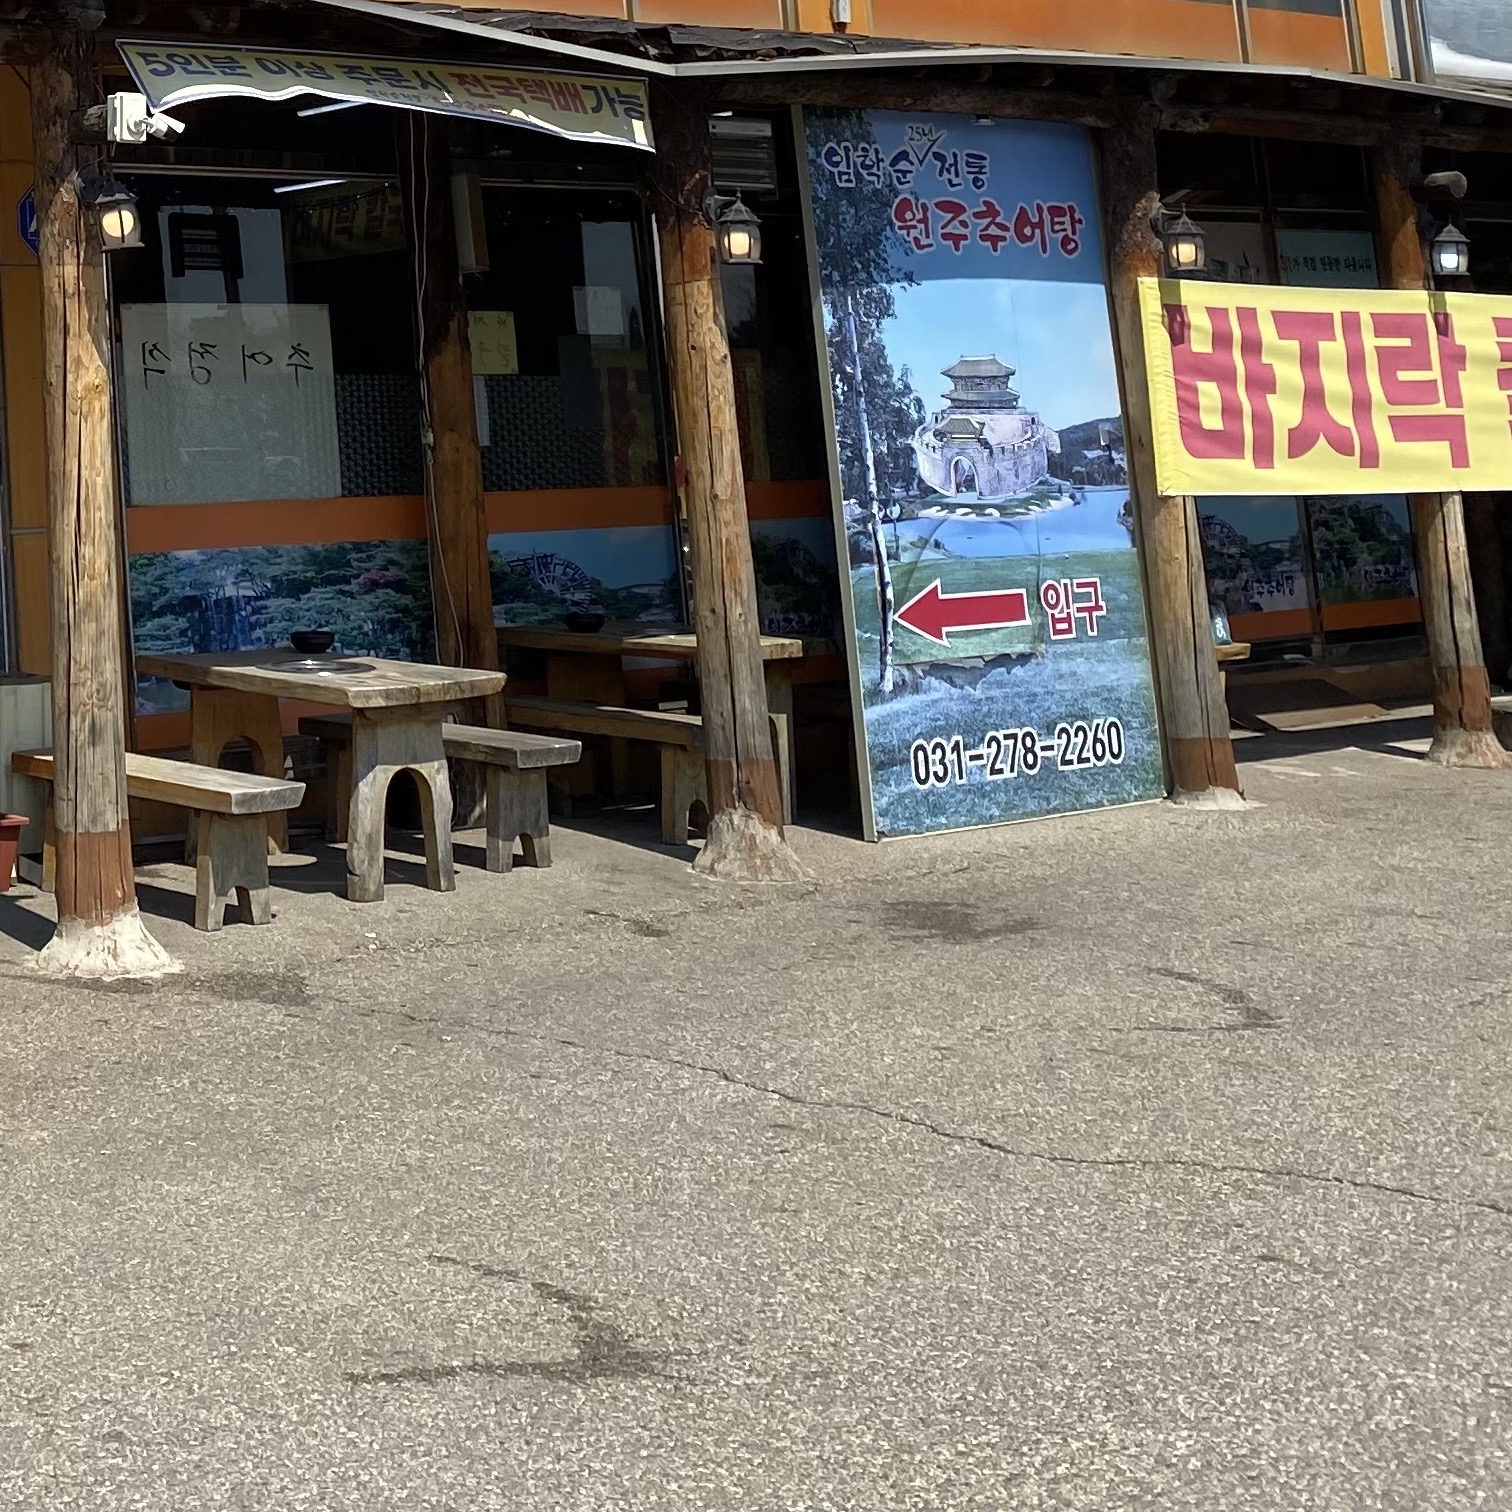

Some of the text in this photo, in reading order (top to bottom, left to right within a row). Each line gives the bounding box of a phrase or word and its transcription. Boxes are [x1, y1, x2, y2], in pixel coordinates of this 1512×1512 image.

[134, 50, 254, 79] 5인분
[255, 57, 336, 82] 이상
[334, 63, 453, 96] 주문시
[906, 124, 936, 143] 25년
[932, 148, 990, 190] 전통
[891, 196, 1084, 258] 원주추어탕
[1164, 304, 1472, 470] 바지락
[1040, 577, 1107, 640] 입구
[910, 716, 1126, 789] 031-278-2260
